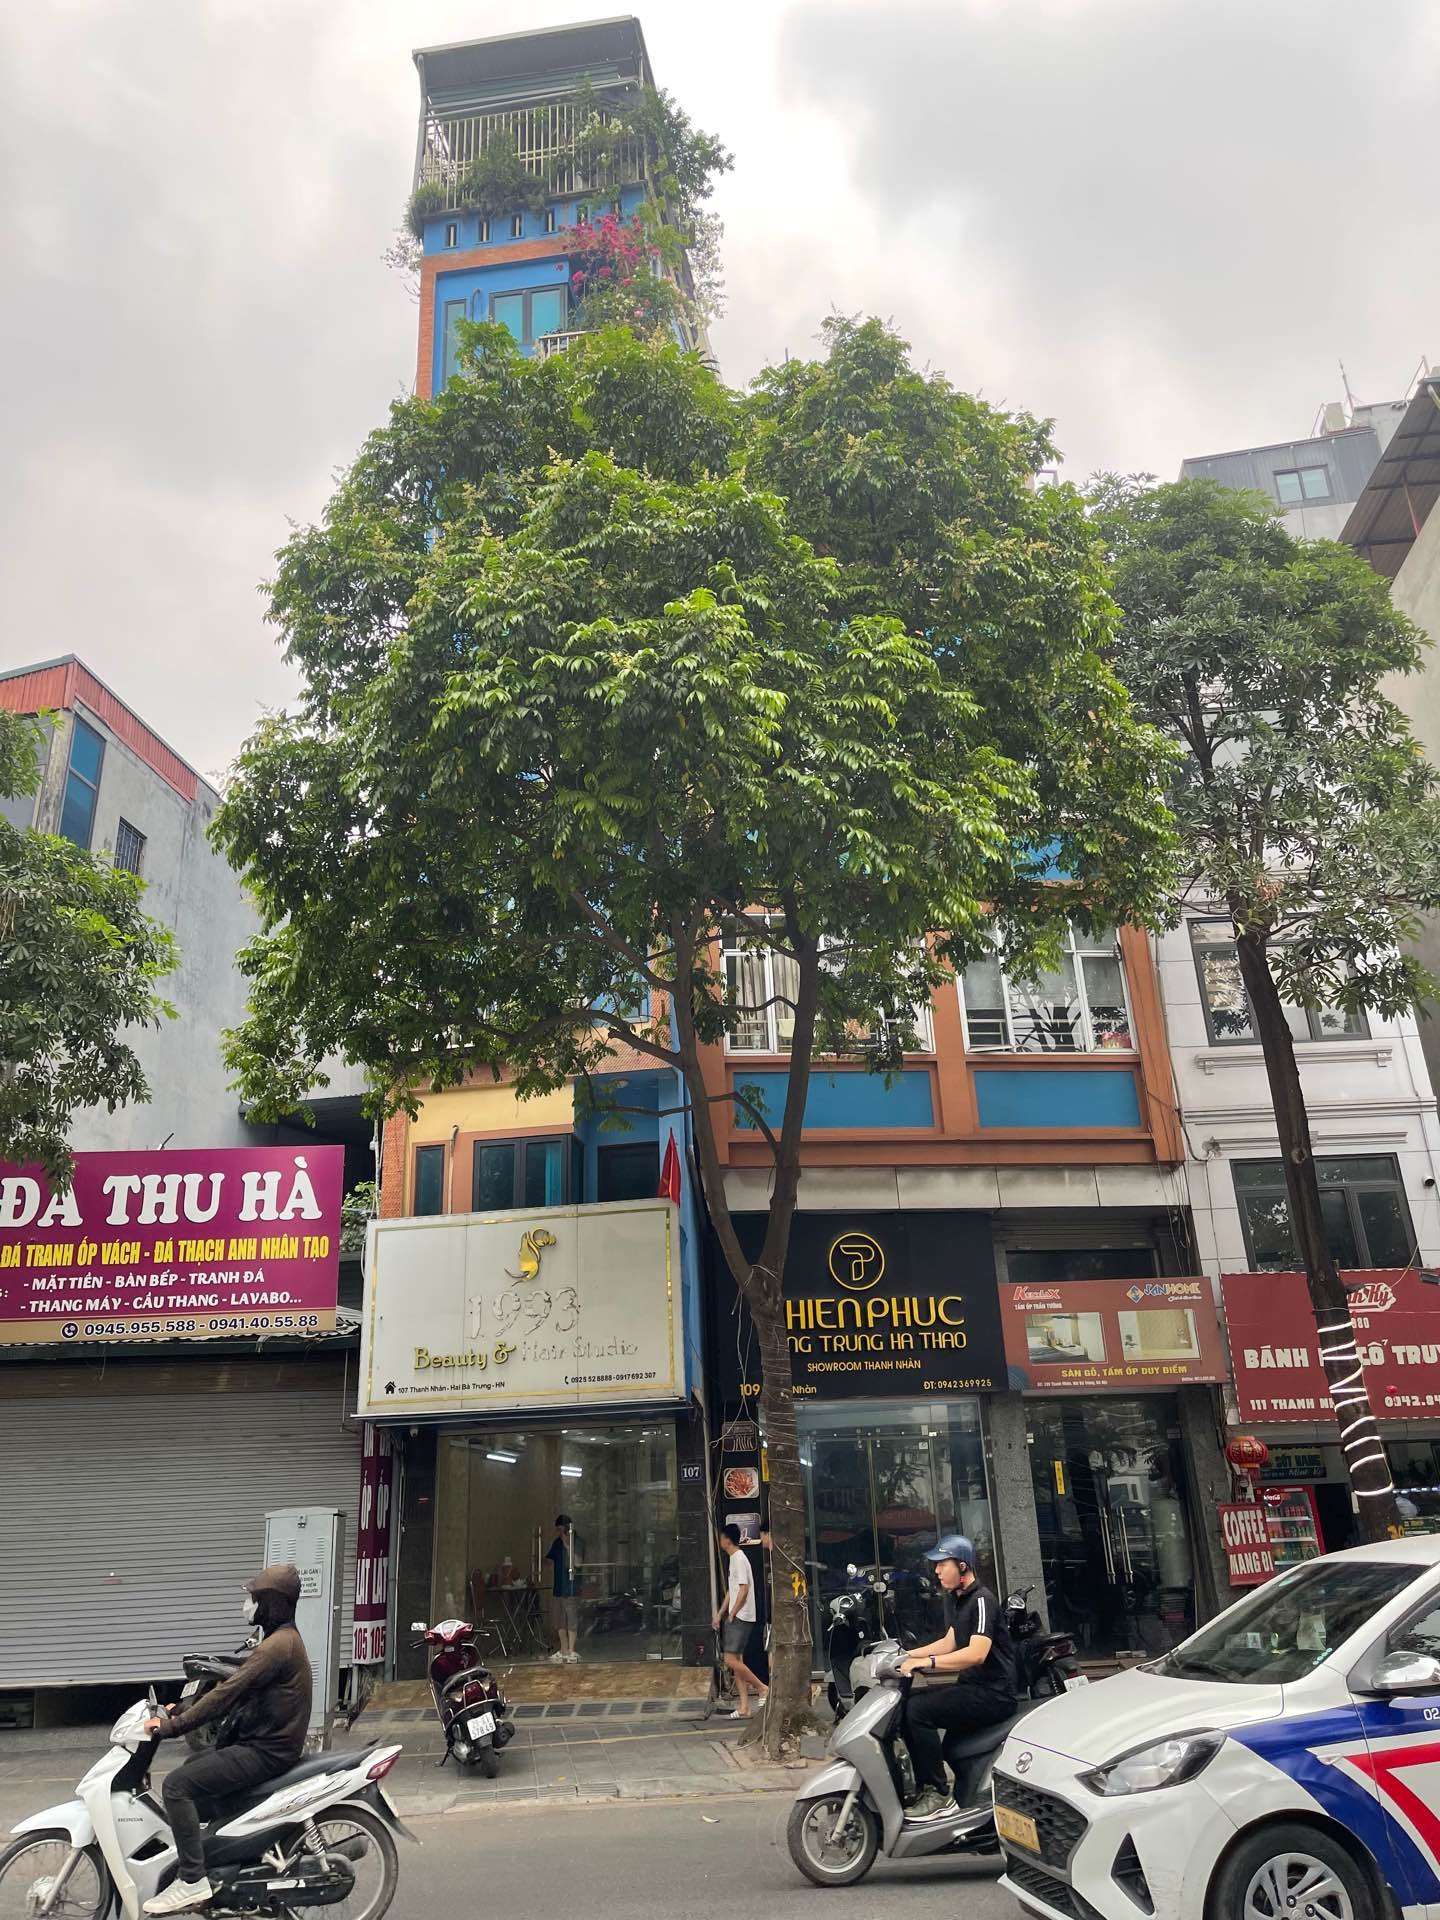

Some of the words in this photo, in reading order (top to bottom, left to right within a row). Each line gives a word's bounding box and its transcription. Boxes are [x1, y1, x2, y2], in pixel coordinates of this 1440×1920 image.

[102, 1172, 225, 1226] THU
[239, 1156, 323, 1222] HÀ
[0, 1241, 21, 1268] ĐÁ
[26, 1243, 74, 1267] TRANH
[77, 1236, 98, 1266] ỐP
[101, 1239, 141, 1265] VÁCH
[154, 1238, 173, 1263] ĐÁ
[178, 1238, 225, 1266] THẠCH
[228, 1237, 257, 1261] ANH
[261, 1233, 299, 1259] NHÂN
[303, 1235, 329, 1262] TẠO
[32, 1274, 67, 1293] MẶT
[114, 1272, 147, 1288] BÀN
[149, 1269, 178, 1287] BẾP
[189, 1271, 240, 1285] TRANH
[243, 1268, 265, 1283] ĐÁ
[29, 1299, 83, 1313] THANG
[85, 1296, 122, 1311] MÁY
[167, 1293, 219, 1308] THANG
[230, 1292, 302, 1306] LAVABO...
[467, 1286, 581, 1341] 1993
[84, 1319, 196, 1336] 0945.955.588
[209, 1315, 318, 1331] 0941.40.55.88
[819, 1333, 884, 1352] TRUNG
[919, 1331, 967, 1349] THAO
[413, 1347, 488, 1370] Beauty
[492, 1341, 517, 1365] &
[807, 1361, 862, 1373] SHOWROOM
[864, 1360, 894, 1371] THANH
[895, 1358, 922, 1370] NHÀN
[1244, 1344, 1310, 1369] BÁNH
[1102, 1367, 1124, 1377] TẤM
[739, 1383, 761, 1397] 109
[792, 1385, 817, 1395] Nhàn
[1250, 1399, 1267, 1410] 111
[1271, 1398, 1315, 1410] THANH
[682, 1466, 700, 1478] 107
[1223, 1508, 1267, 1547] COFFEE
[1229, 1551, 1260, 1576] MANG
[353, 1626, 368, 1660] 105
[370, 1625, 386, 1658] 105
